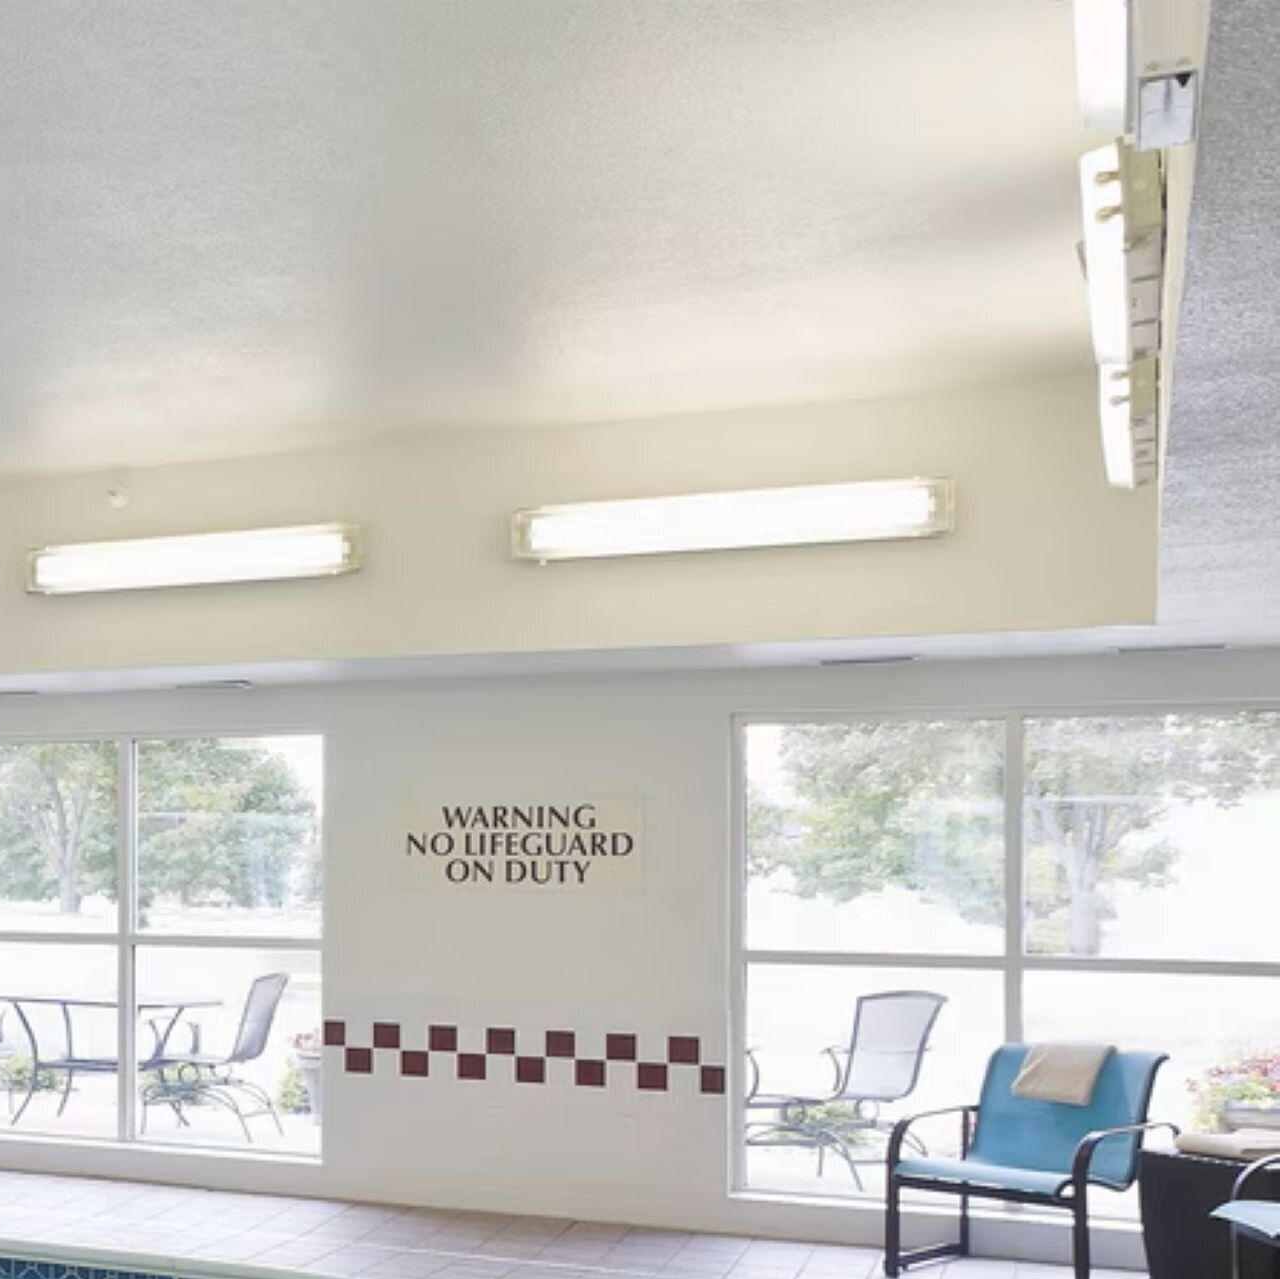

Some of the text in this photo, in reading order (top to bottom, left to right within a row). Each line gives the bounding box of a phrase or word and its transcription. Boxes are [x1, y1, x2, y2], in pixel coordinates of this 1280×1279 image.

[442, 804, 596, 829] WARNING
[406, 832, 634, 857] NO LIFEGUARD
[445, 859, 590, 885] ON DUTY
